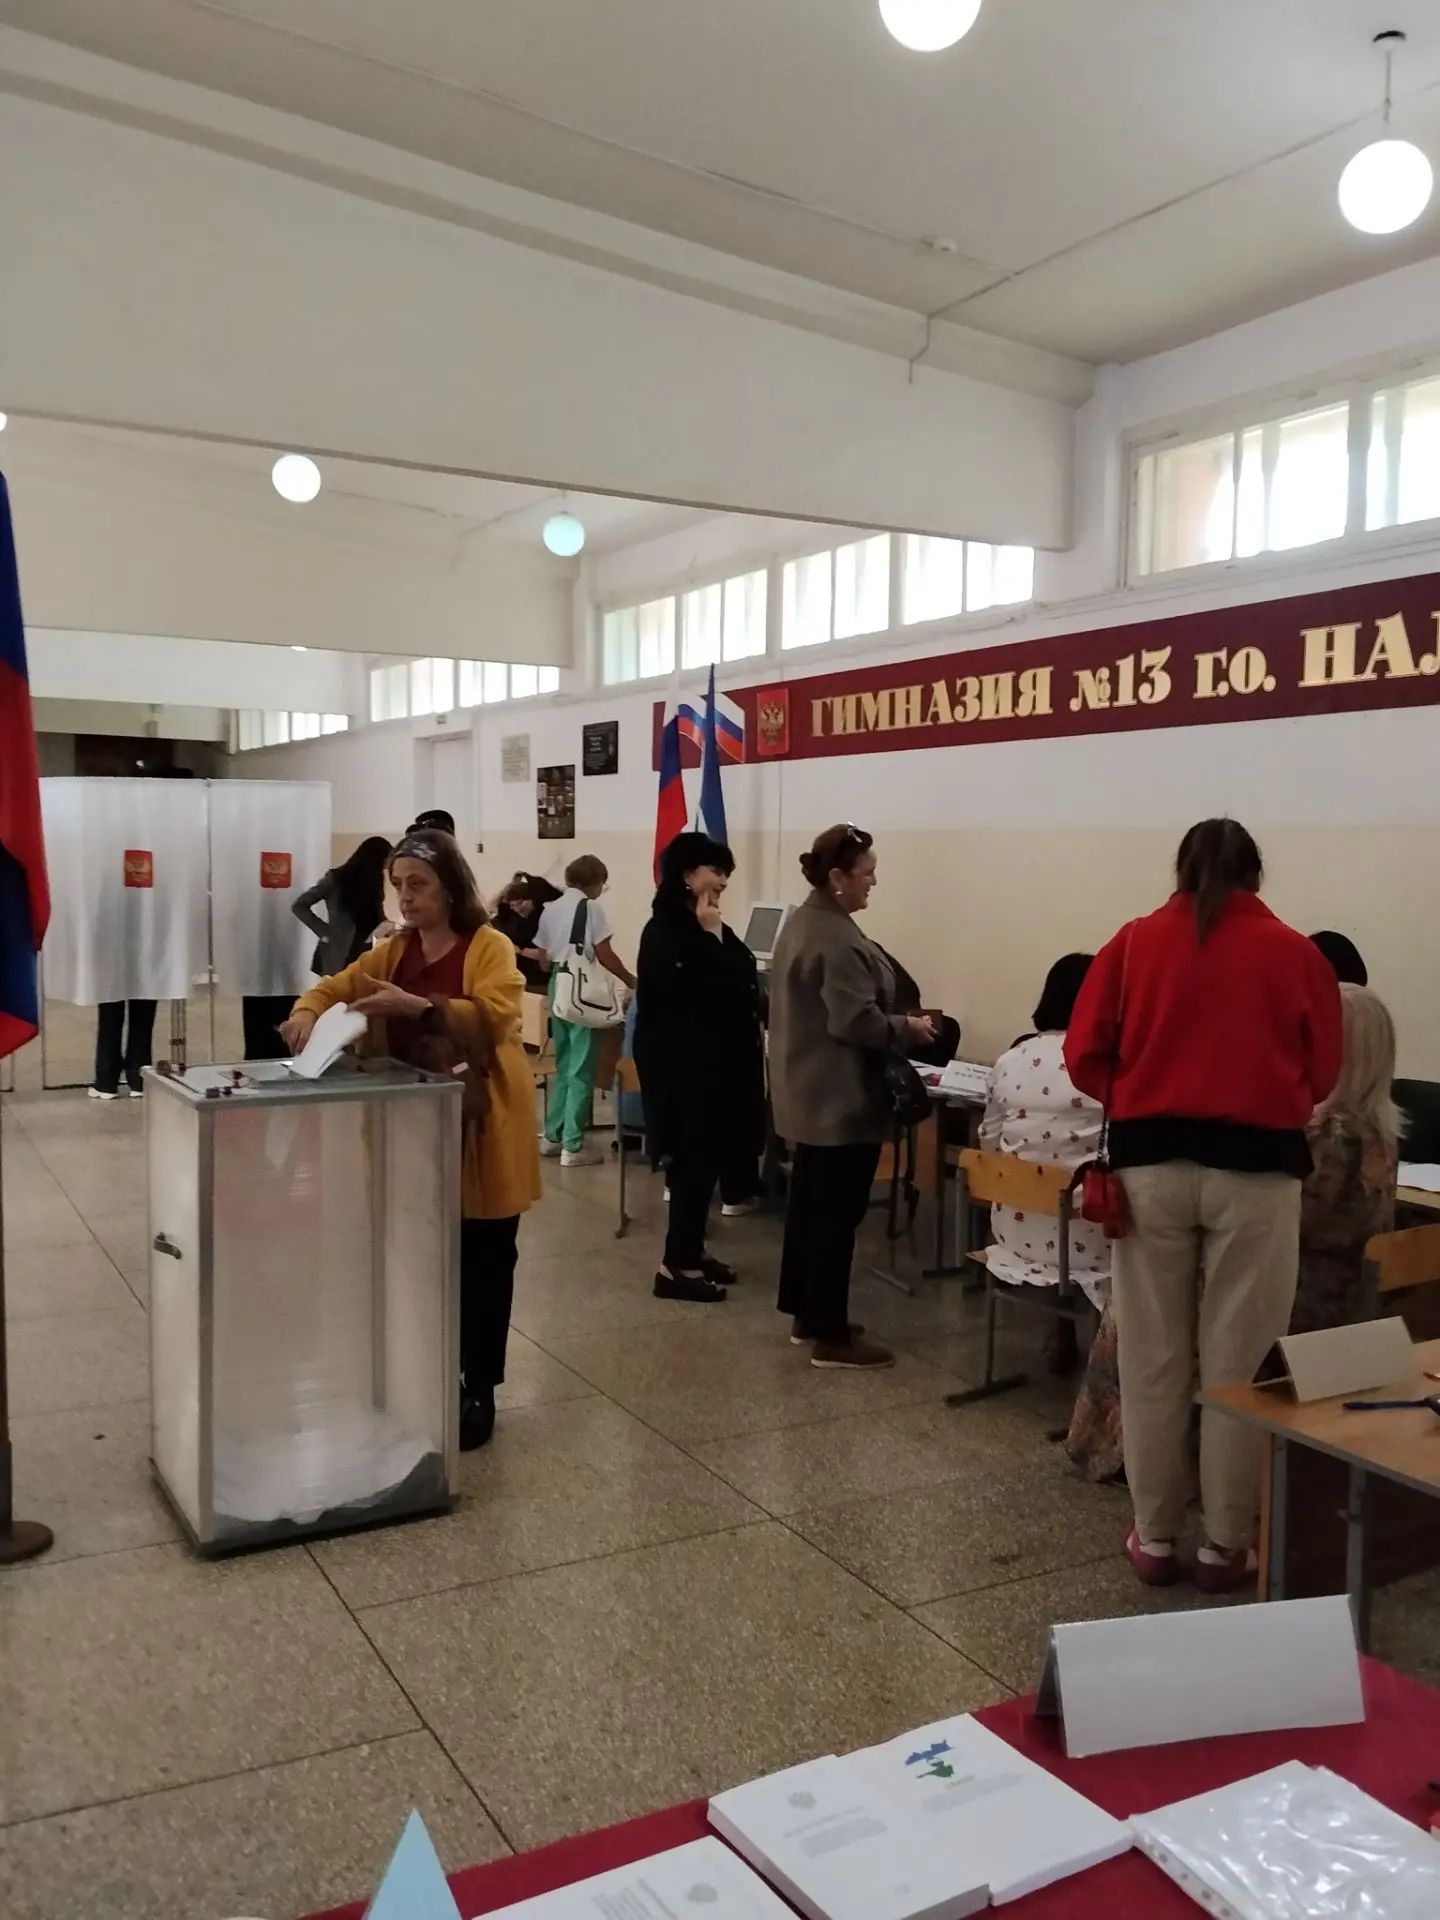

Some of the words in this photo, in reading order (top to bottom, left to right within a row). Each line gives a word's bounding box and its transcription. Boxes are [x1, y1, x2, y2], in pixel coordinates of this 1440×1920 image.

[811, 666, 1054, 738] ГИМНАЗИЯ
[1069, 645, 1173, 712] №13
[1193, 645, 1277, 699] Г.О.
